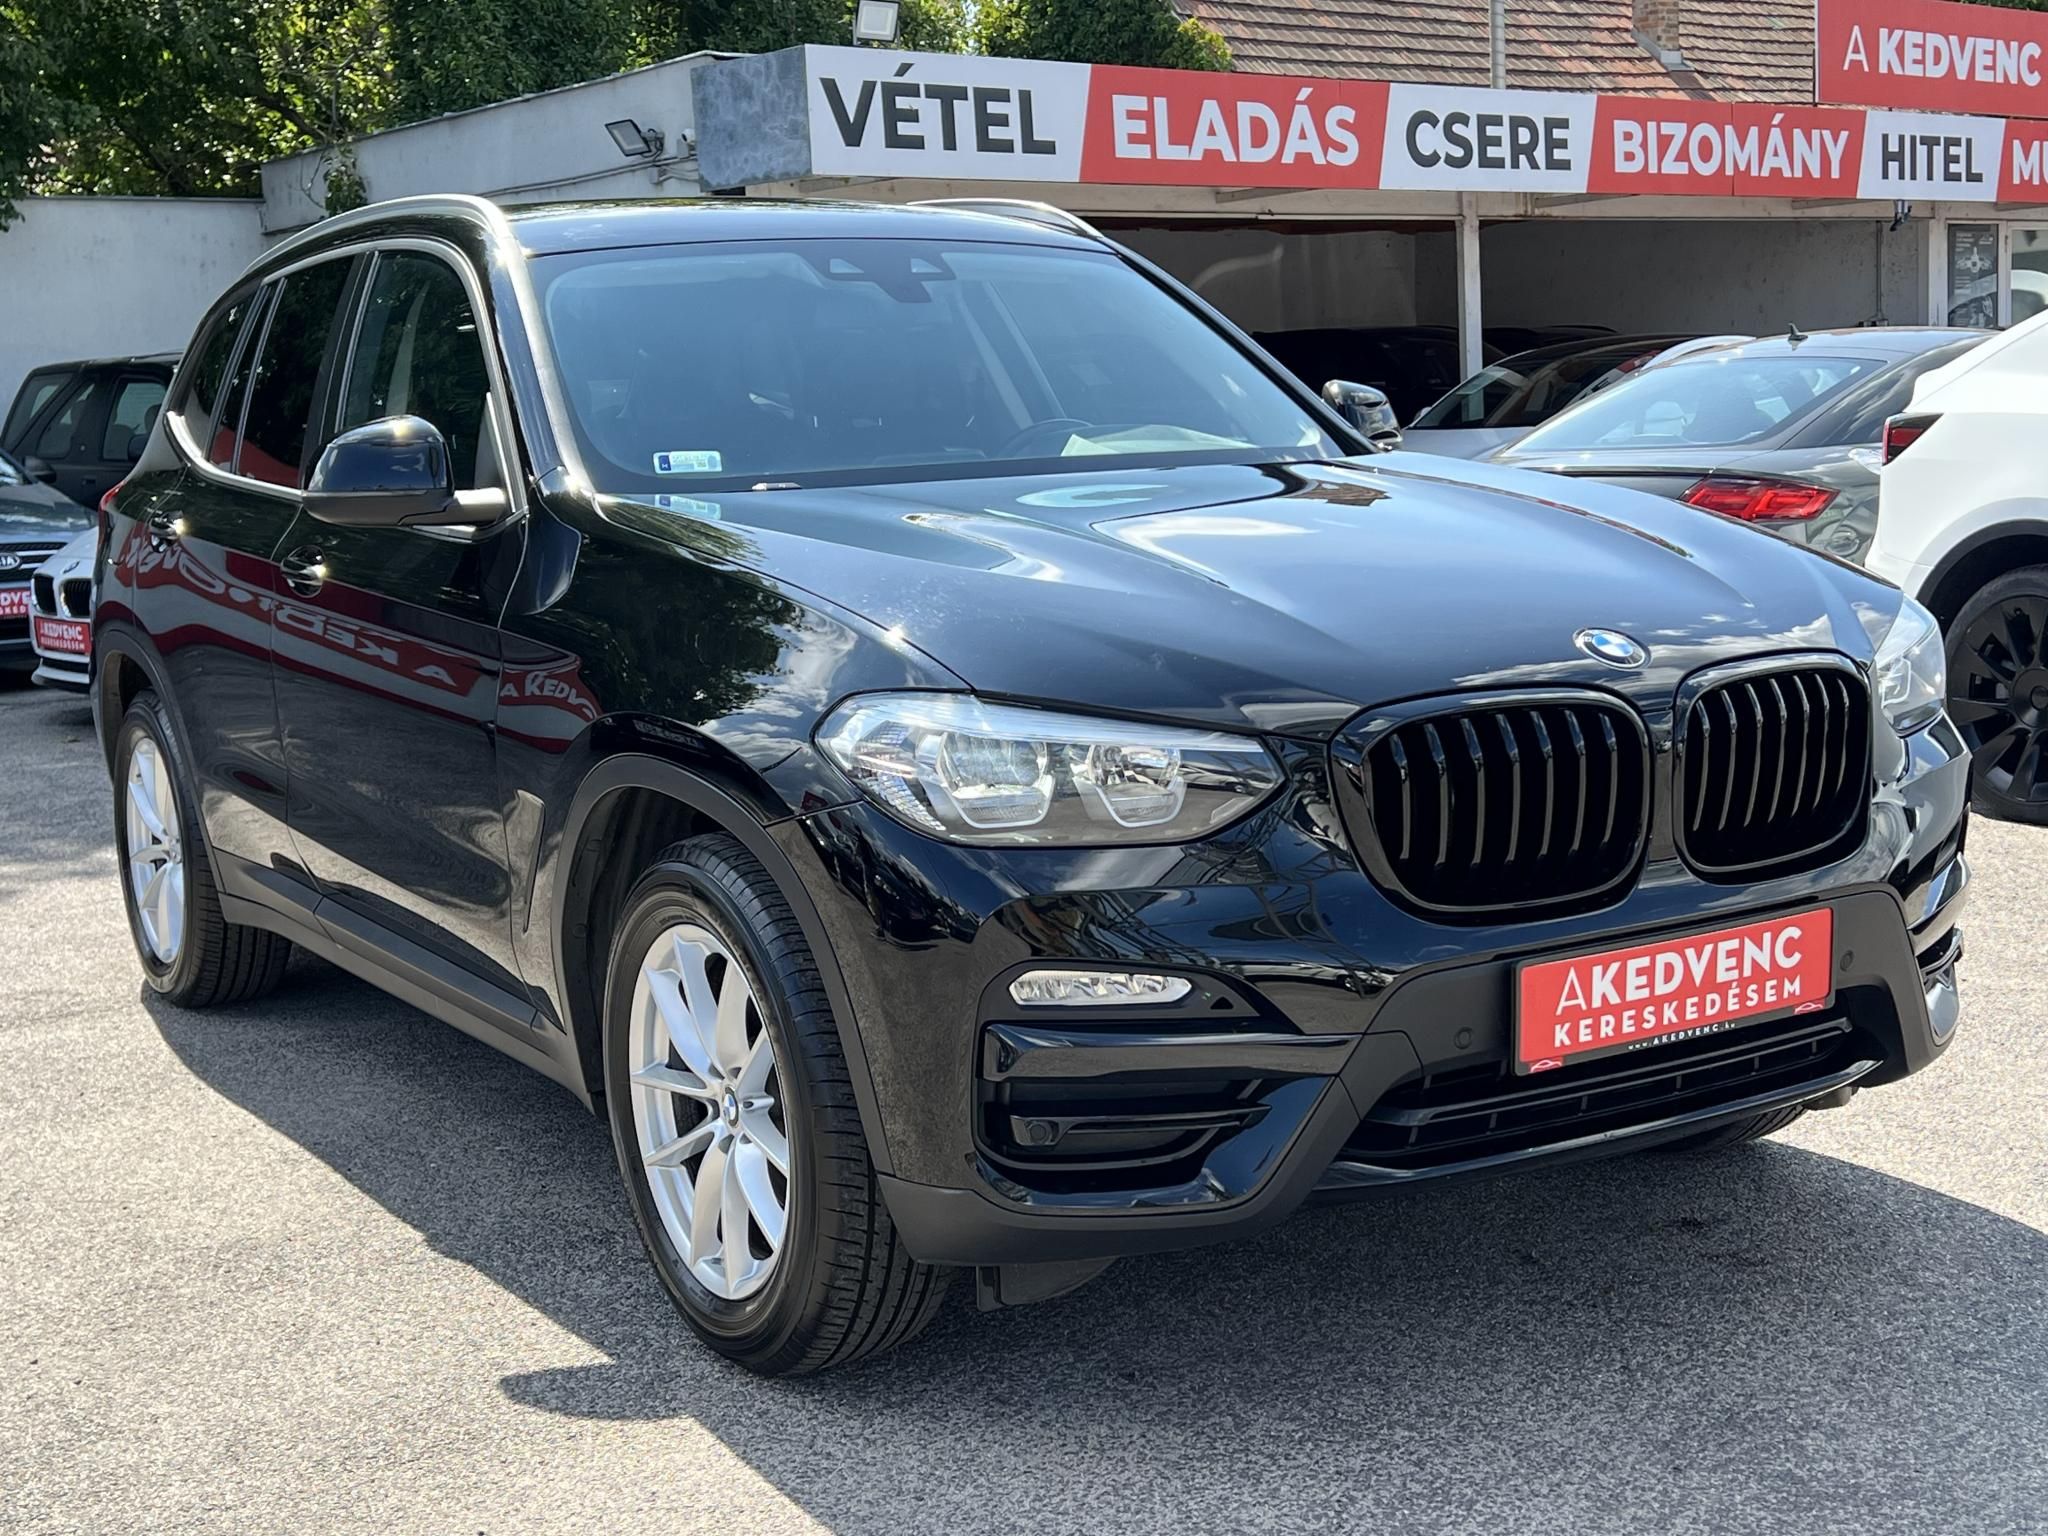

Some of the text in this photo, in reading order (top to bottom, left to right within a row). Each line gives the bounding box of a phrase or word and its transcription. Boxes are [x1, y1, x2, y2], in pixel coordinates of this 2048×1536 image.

[1843, 24, 2042, 86] A KEDVENC
[819, 62, 2048, 186] VÉTEL ELADÁS CSERE BIZOMÁNY HITEL M
[1591, 926, 1802, 1009] KEDVENC
[1554, 974, 1802, 1048] KERESKEDÉSEM
